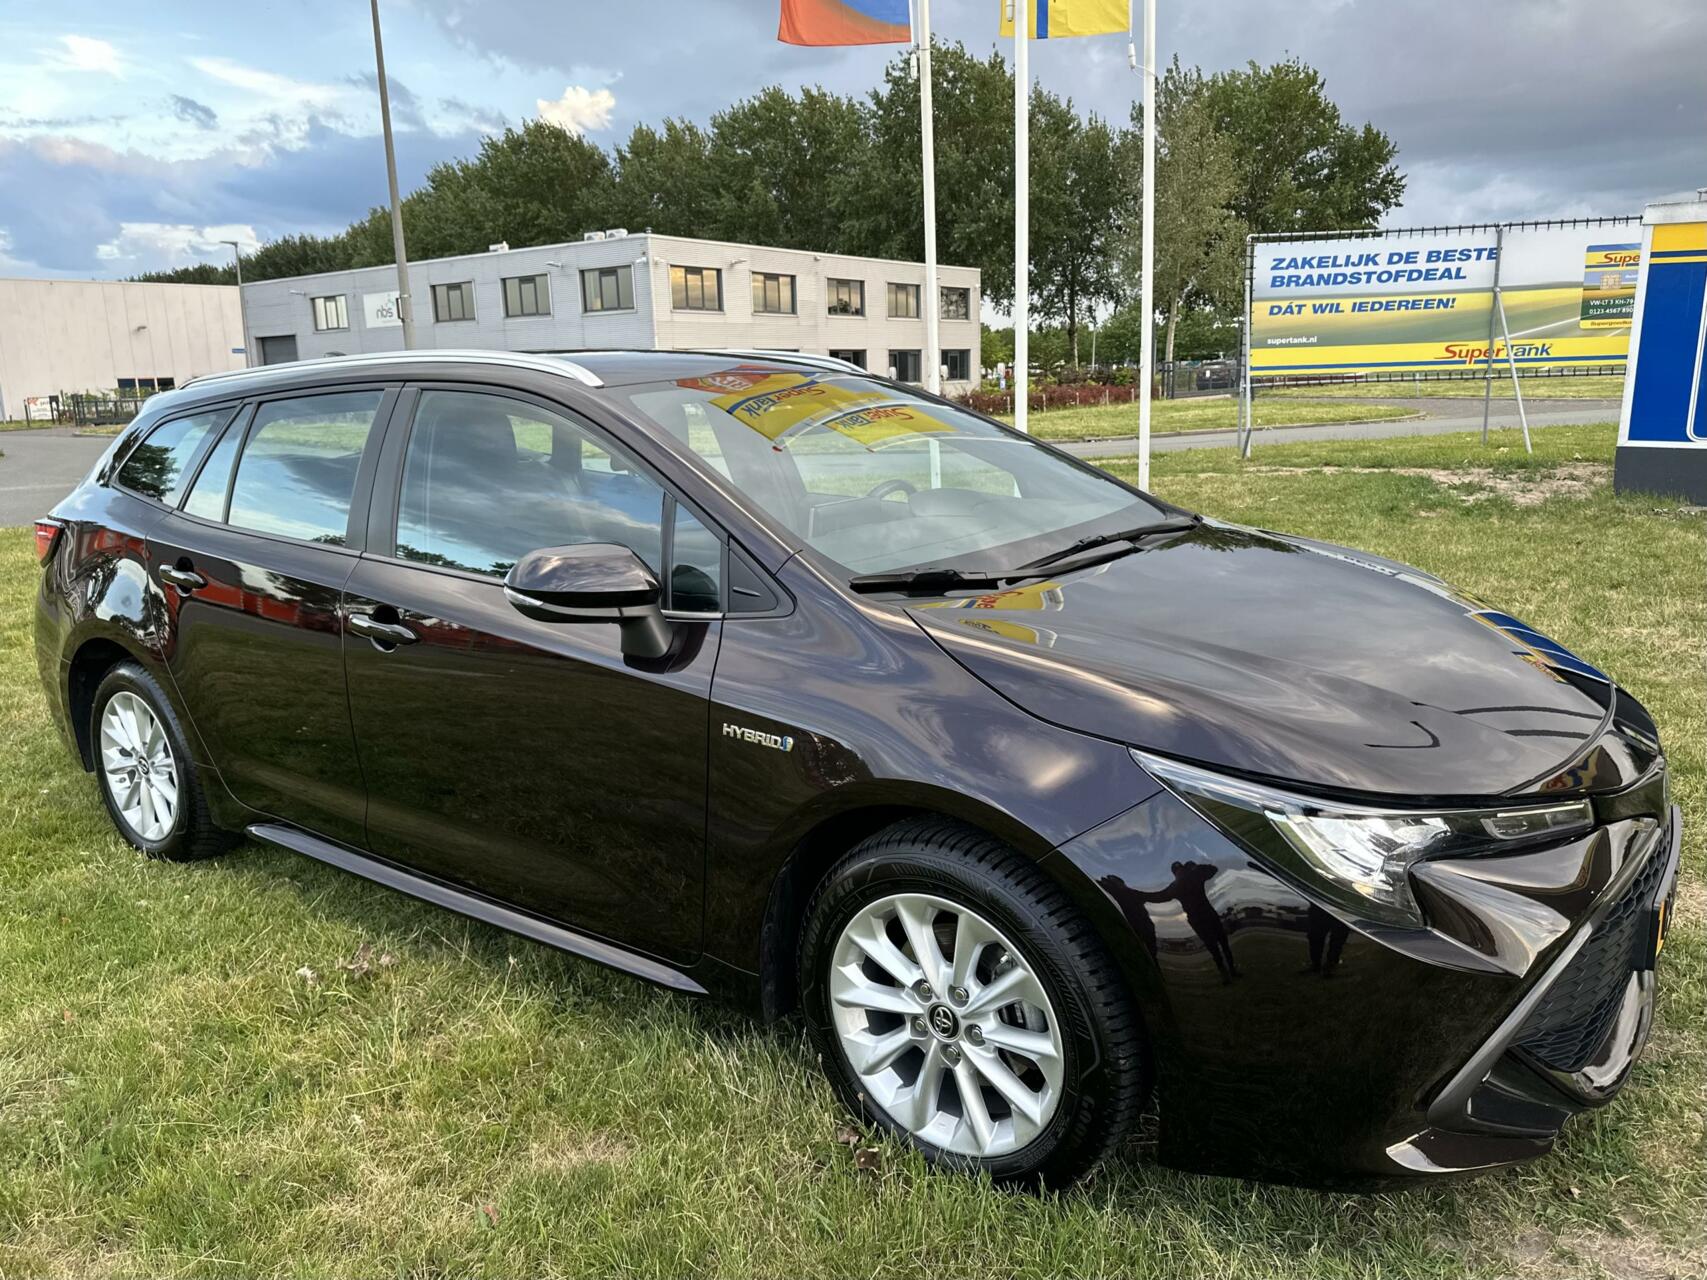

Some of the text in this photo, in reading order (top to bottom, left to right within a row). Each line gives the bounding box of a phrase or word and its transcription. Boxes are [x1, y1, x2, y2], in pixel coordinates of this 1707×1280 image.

[1270, 247, 1502, 271] ZAKELIJK DE BESTE
[1270, 267, 1467, 288] BRANDSTOFDEAL
[376, 304, 394, 320] nbs
[1268, 297, 1457, 316] DÁT WIL IEDEREEN!
[1267, 335, 1318, 345] supertank.nl
[1434, 343, 1552, 365] SuperTank
[722, 722, 783, 749] HYBRID
